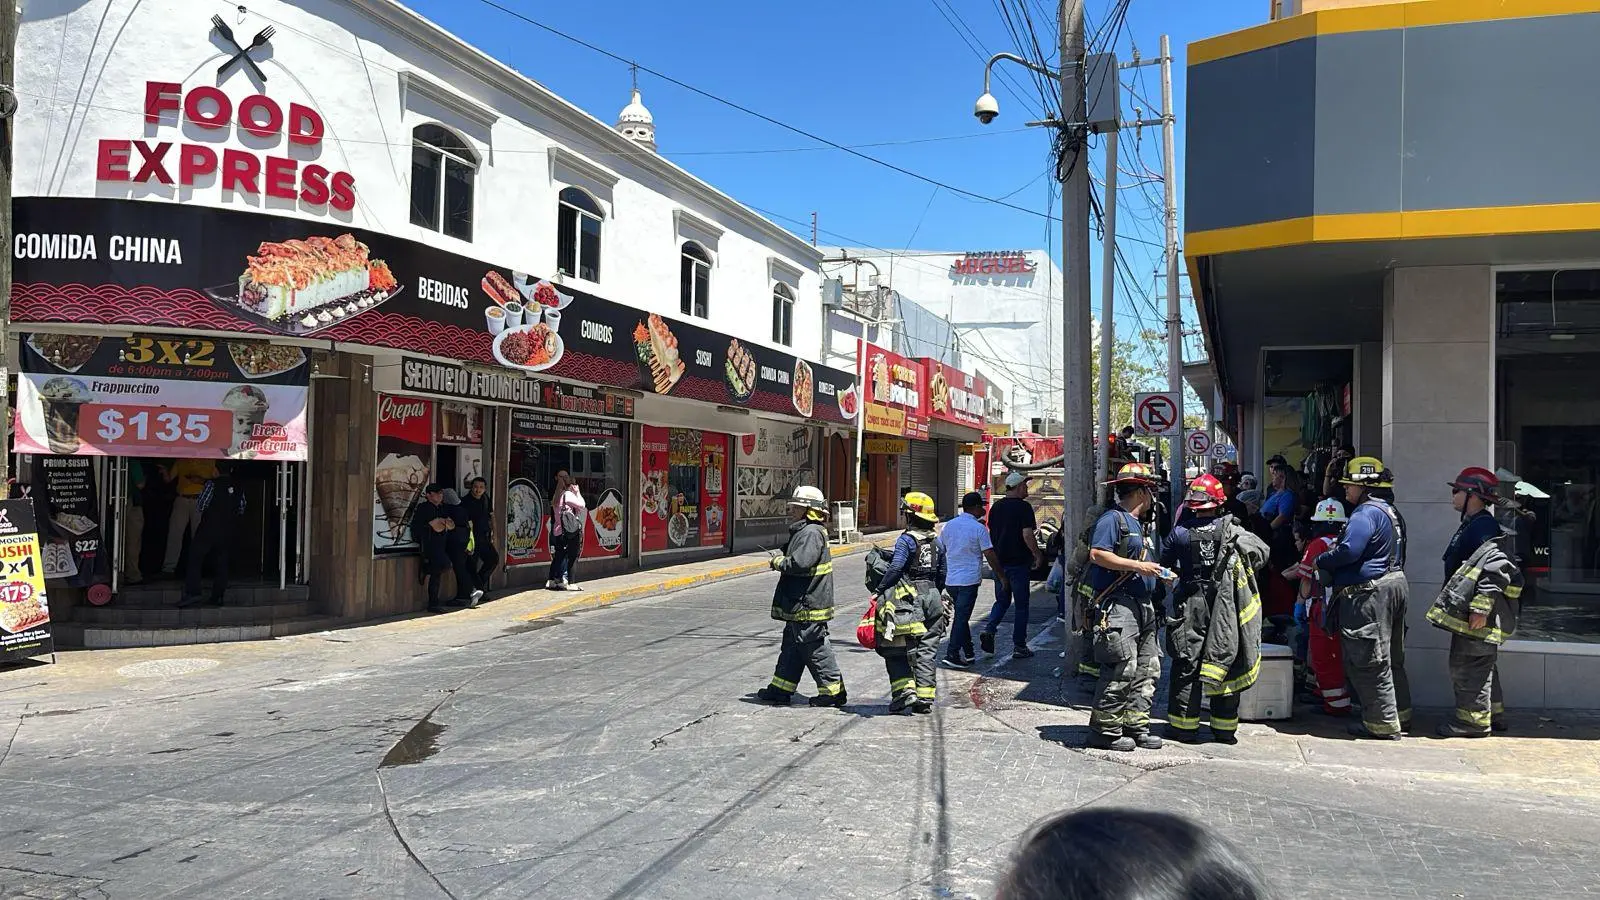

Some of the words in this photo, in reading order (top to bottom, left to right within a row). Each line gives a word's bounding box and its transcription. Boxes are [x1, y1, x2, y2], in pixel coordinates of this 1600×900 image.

[144, 80, 324, 146] FOOD
[97, 139, 356, 212] EXPRESS
[14, 233, 97, 260] COMIDA
[109, 235, 182, 264] CHINA
[418, 276, 469, 309] BEBIDAS
[581, 319, 613, 344] COMBOS
[695, 349, 712, 367] SUSHI
[108, 364, 124, 375] de
[127, 365, 172, 377] 6:00pm
[186, 367, 230, 379] 7:00pm
[404, 360, 467, 395] SERVICIO
[470, 372, 480, 392] A
[481, 374, 541, 404] DOMICILIO
[91, 380, 160, 395] Frappuccino
[379, 397, 427, 425] Crepas
[97, 408, 211, 443] $135
[251, 423, 289, 437] Fresas
[240, 439, 260, 451] con
[262, 439, 298, 451] Crema
[1534, 547, 1550, 555] WC
